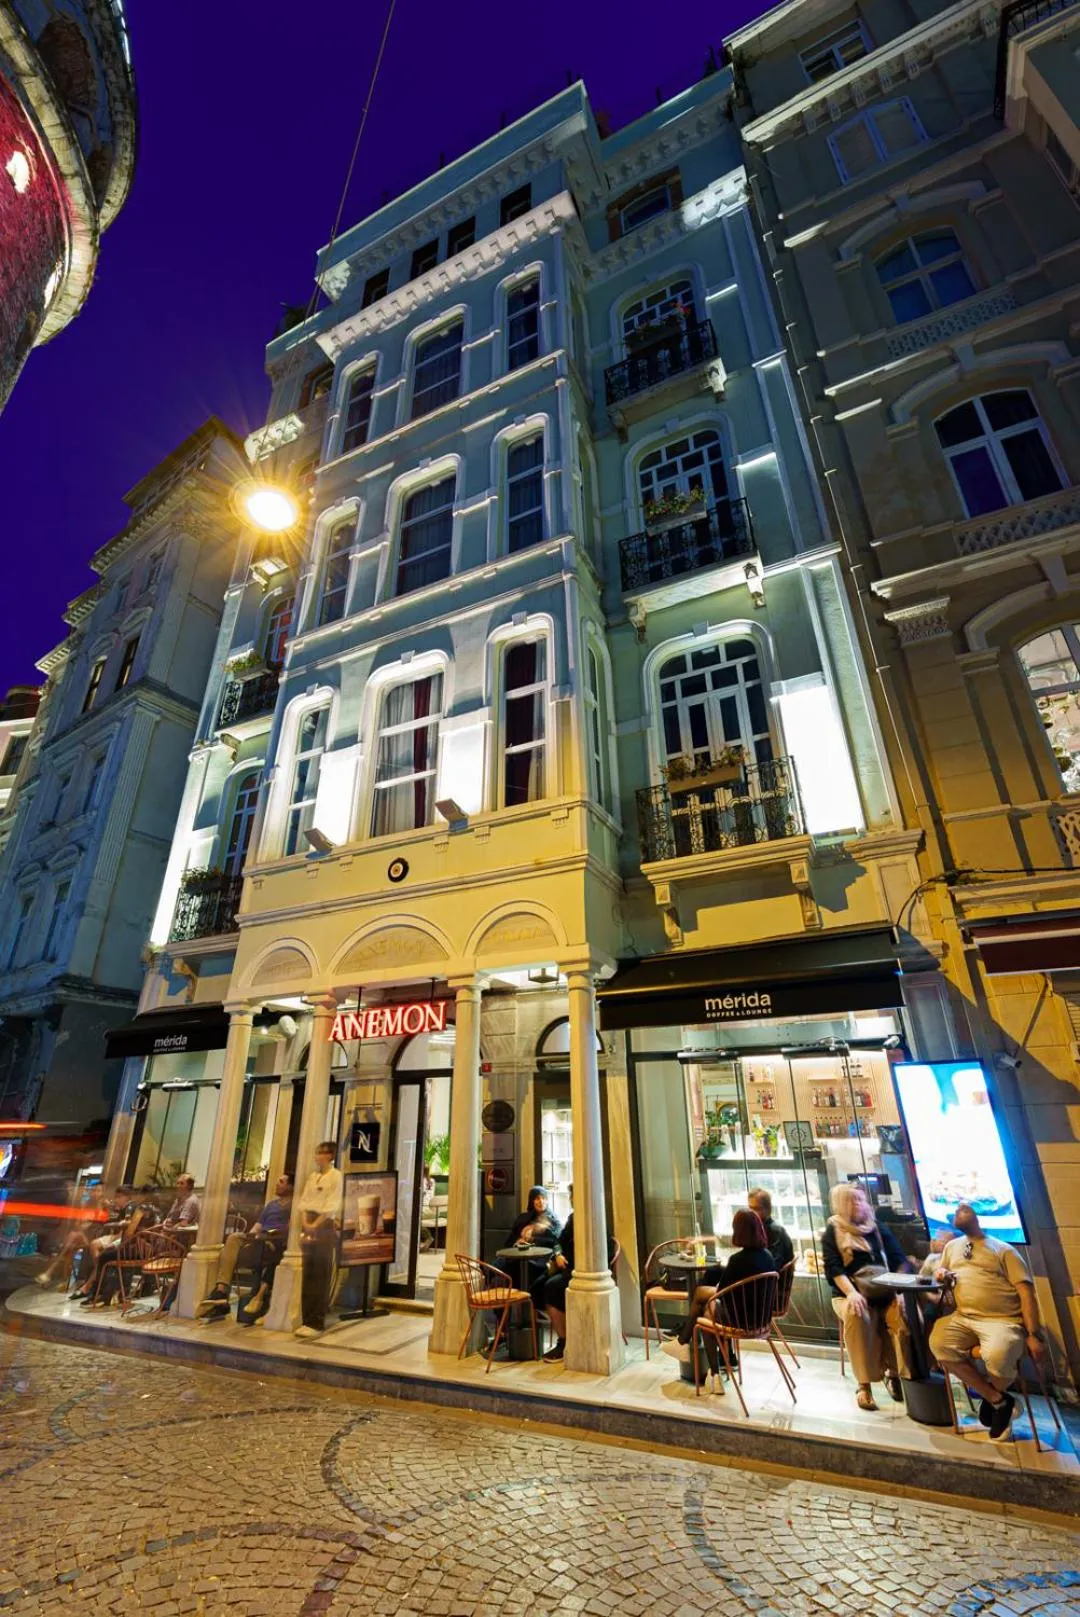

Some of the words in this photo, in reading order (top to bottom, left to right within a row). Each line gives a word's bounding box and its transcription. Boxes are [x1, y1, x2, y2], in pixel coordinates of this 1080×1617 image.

[705, 991, 771, 1011] mérida
[328, 1002, 445, 1041] ANEMON
[154, 1034, 188, 1048] mérida
